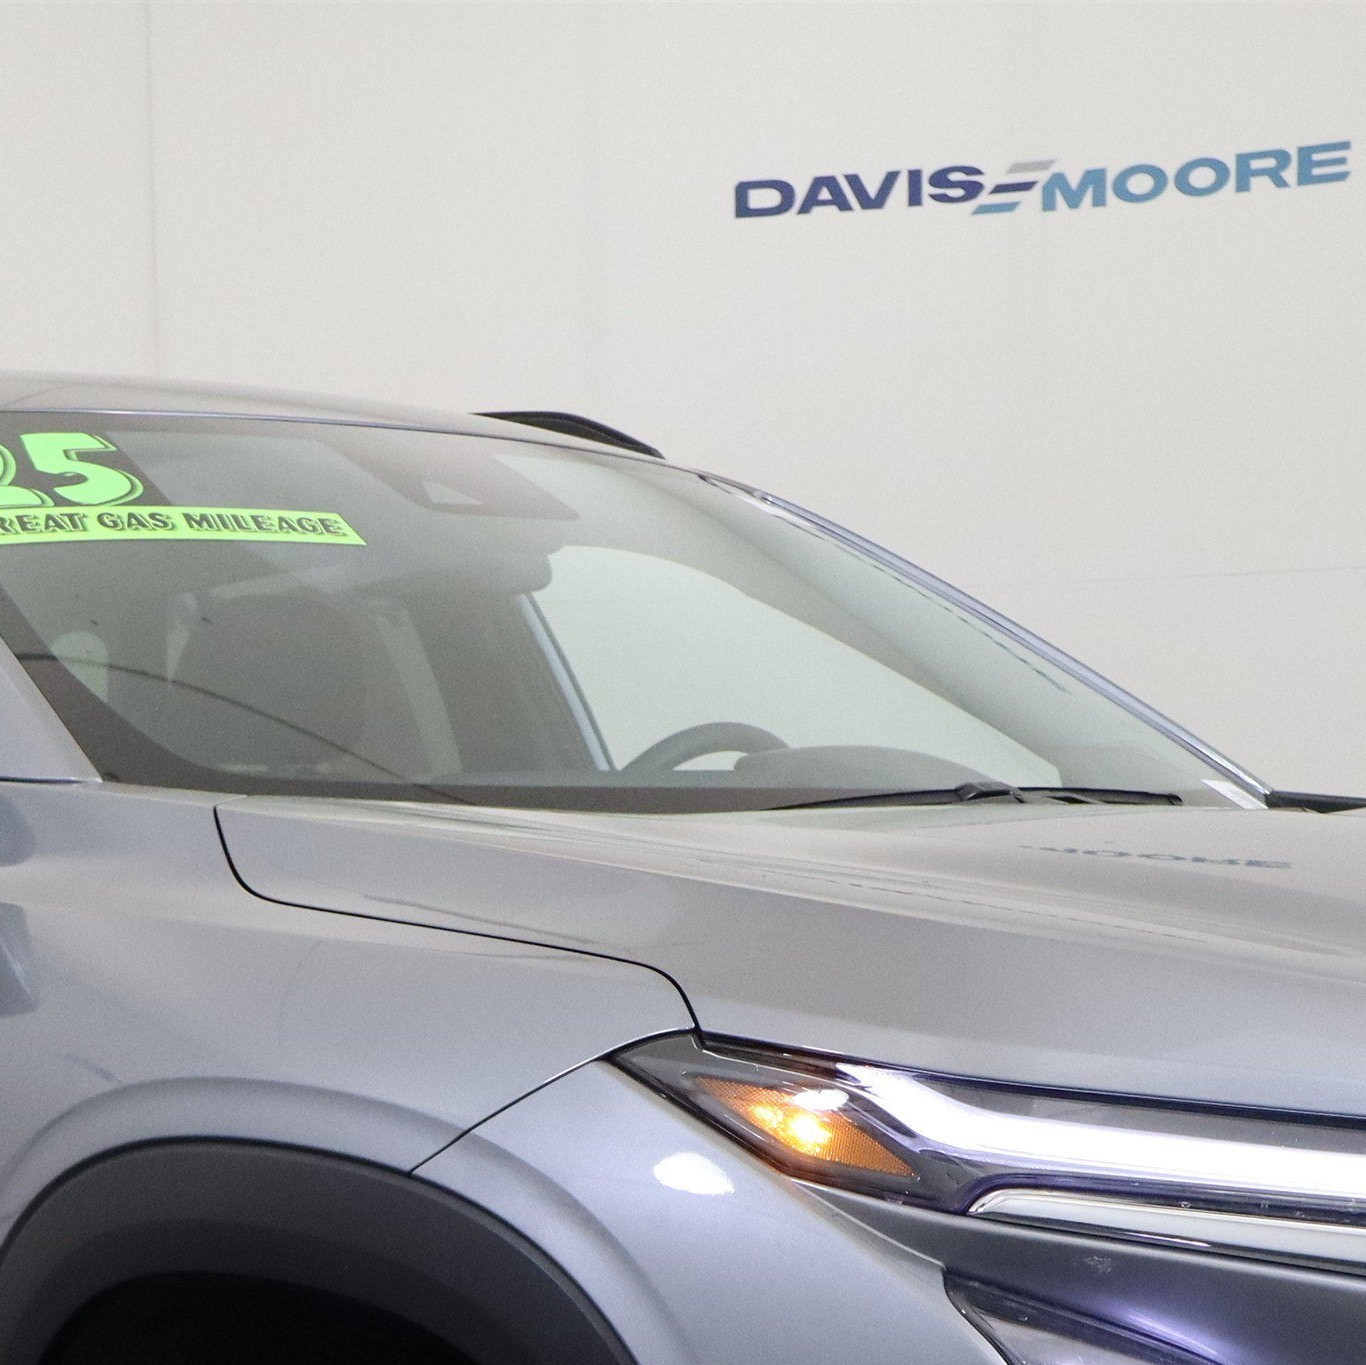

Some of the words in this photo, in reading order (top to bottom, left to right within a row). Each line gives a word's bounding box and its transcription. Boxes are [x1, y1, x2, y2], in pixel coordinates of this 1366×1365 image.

[734, 165, 985, 219] DAVIS
[1040, 140, 1353, 212] MOORE
[96, 511, 176, 533] GAS
[182, 512, 348, 537] MILEAGE
